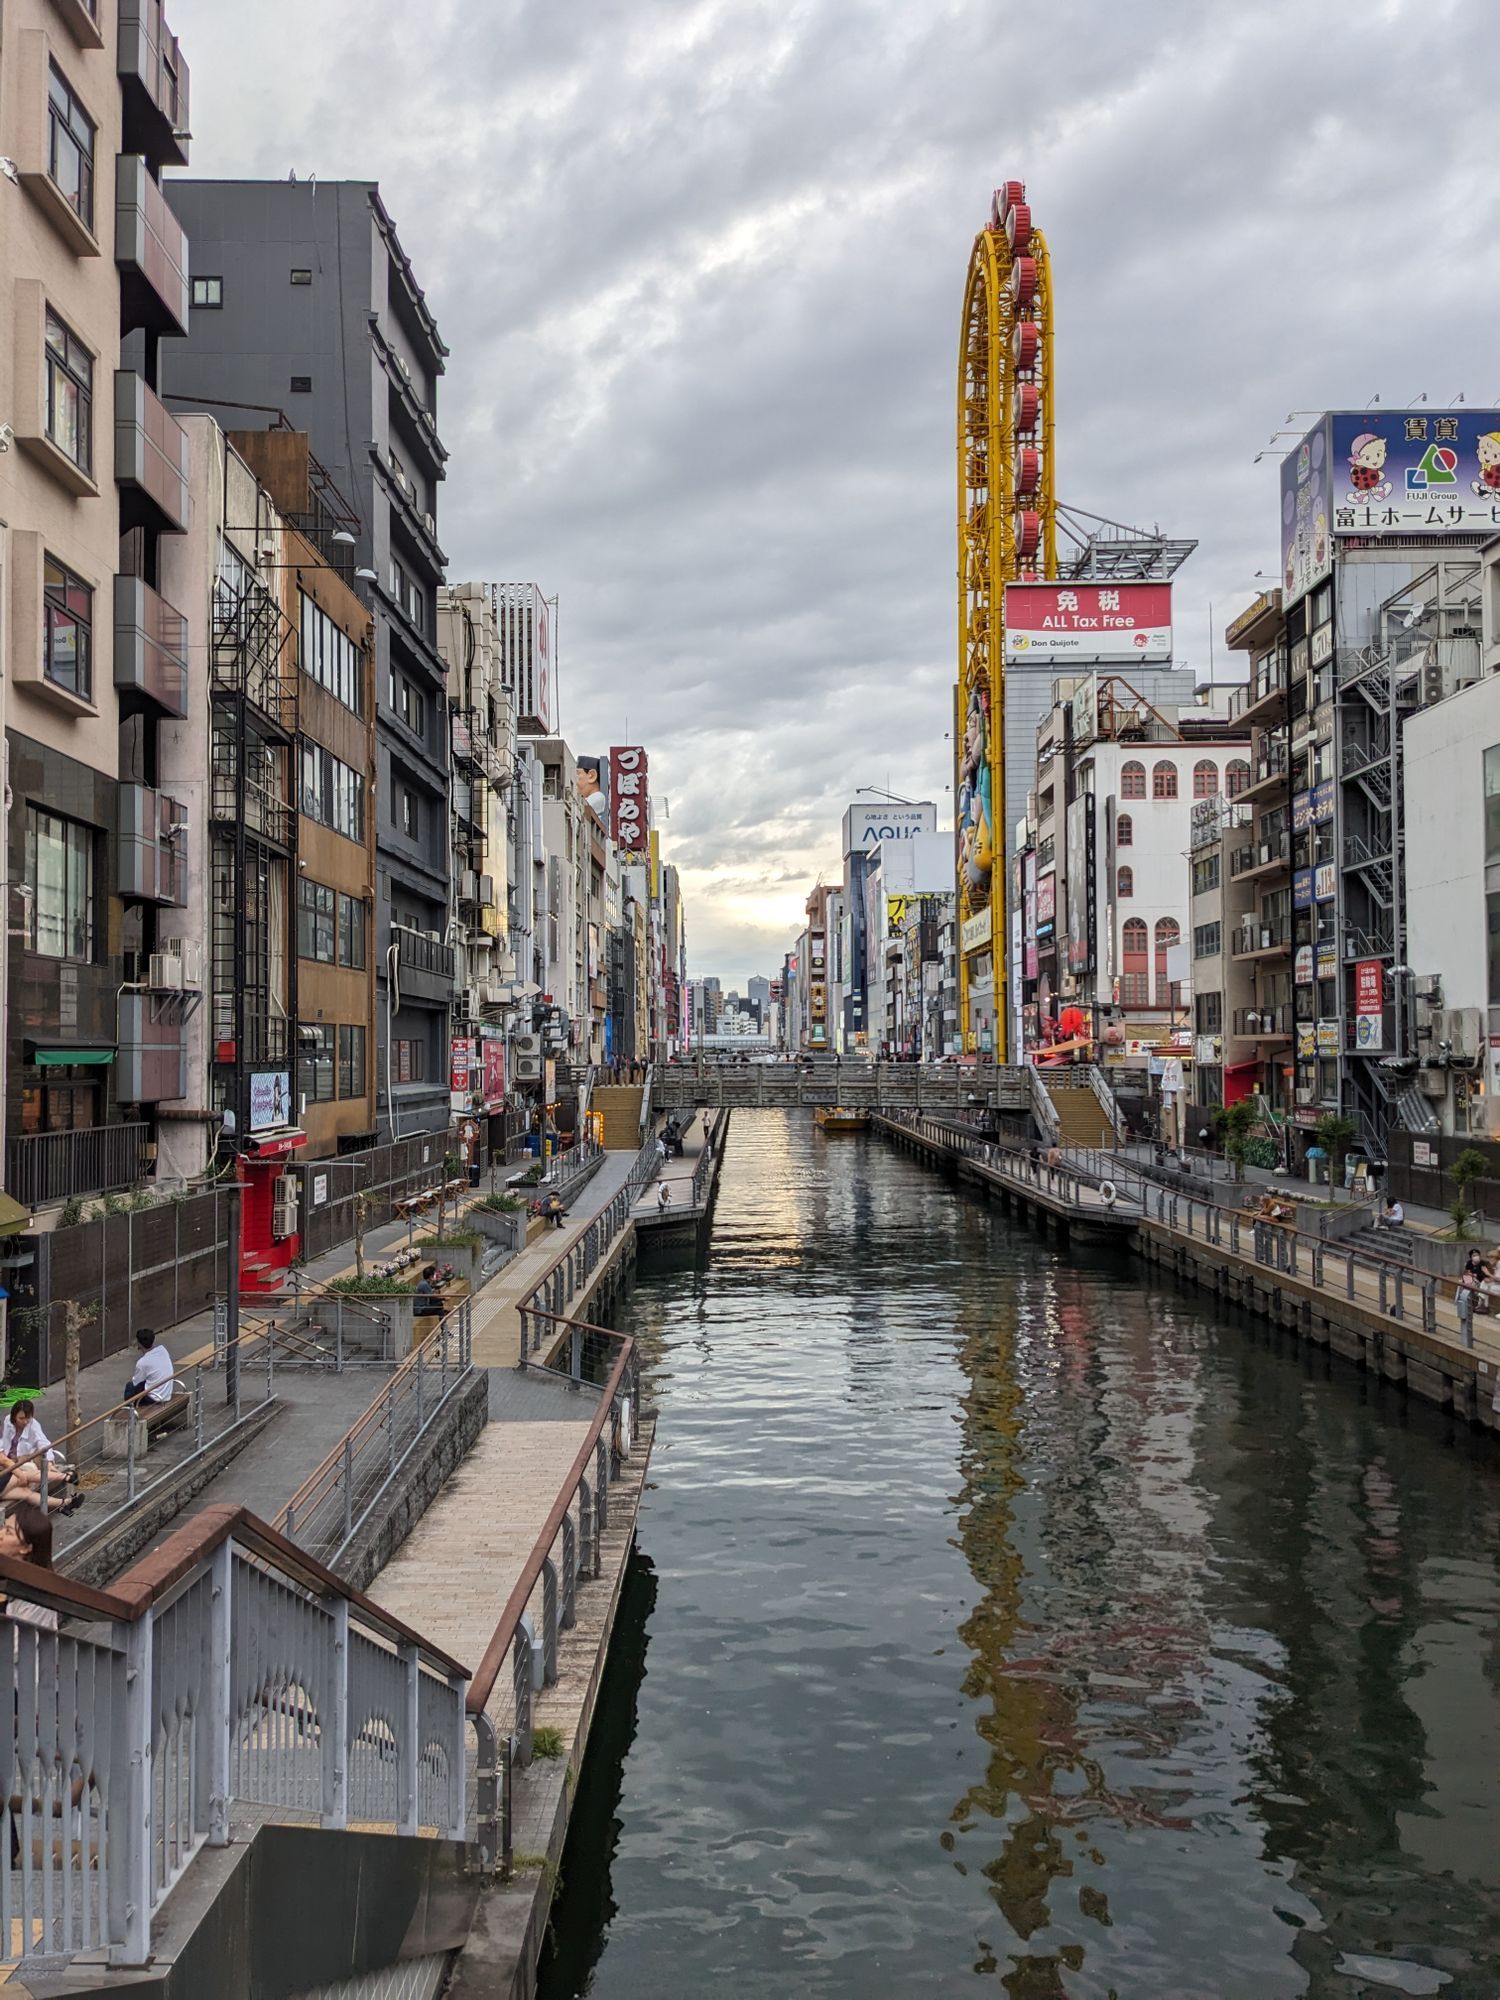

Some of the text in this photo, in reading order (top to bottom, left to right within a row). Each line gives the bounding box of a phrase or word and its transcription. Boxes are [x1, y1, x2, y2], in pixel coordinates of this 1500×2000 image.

[1404, 418, 1458, 441] 賃貸
[1407, 492, 1458, 501] FUJI Group
[1057, 590, 1120, 612] 免税
[1042, 614, 1136, 628] ALL Tax Free
[1049, 639, 1079, 648] Quijote
[617, 748, 642, 845] づぼらや
